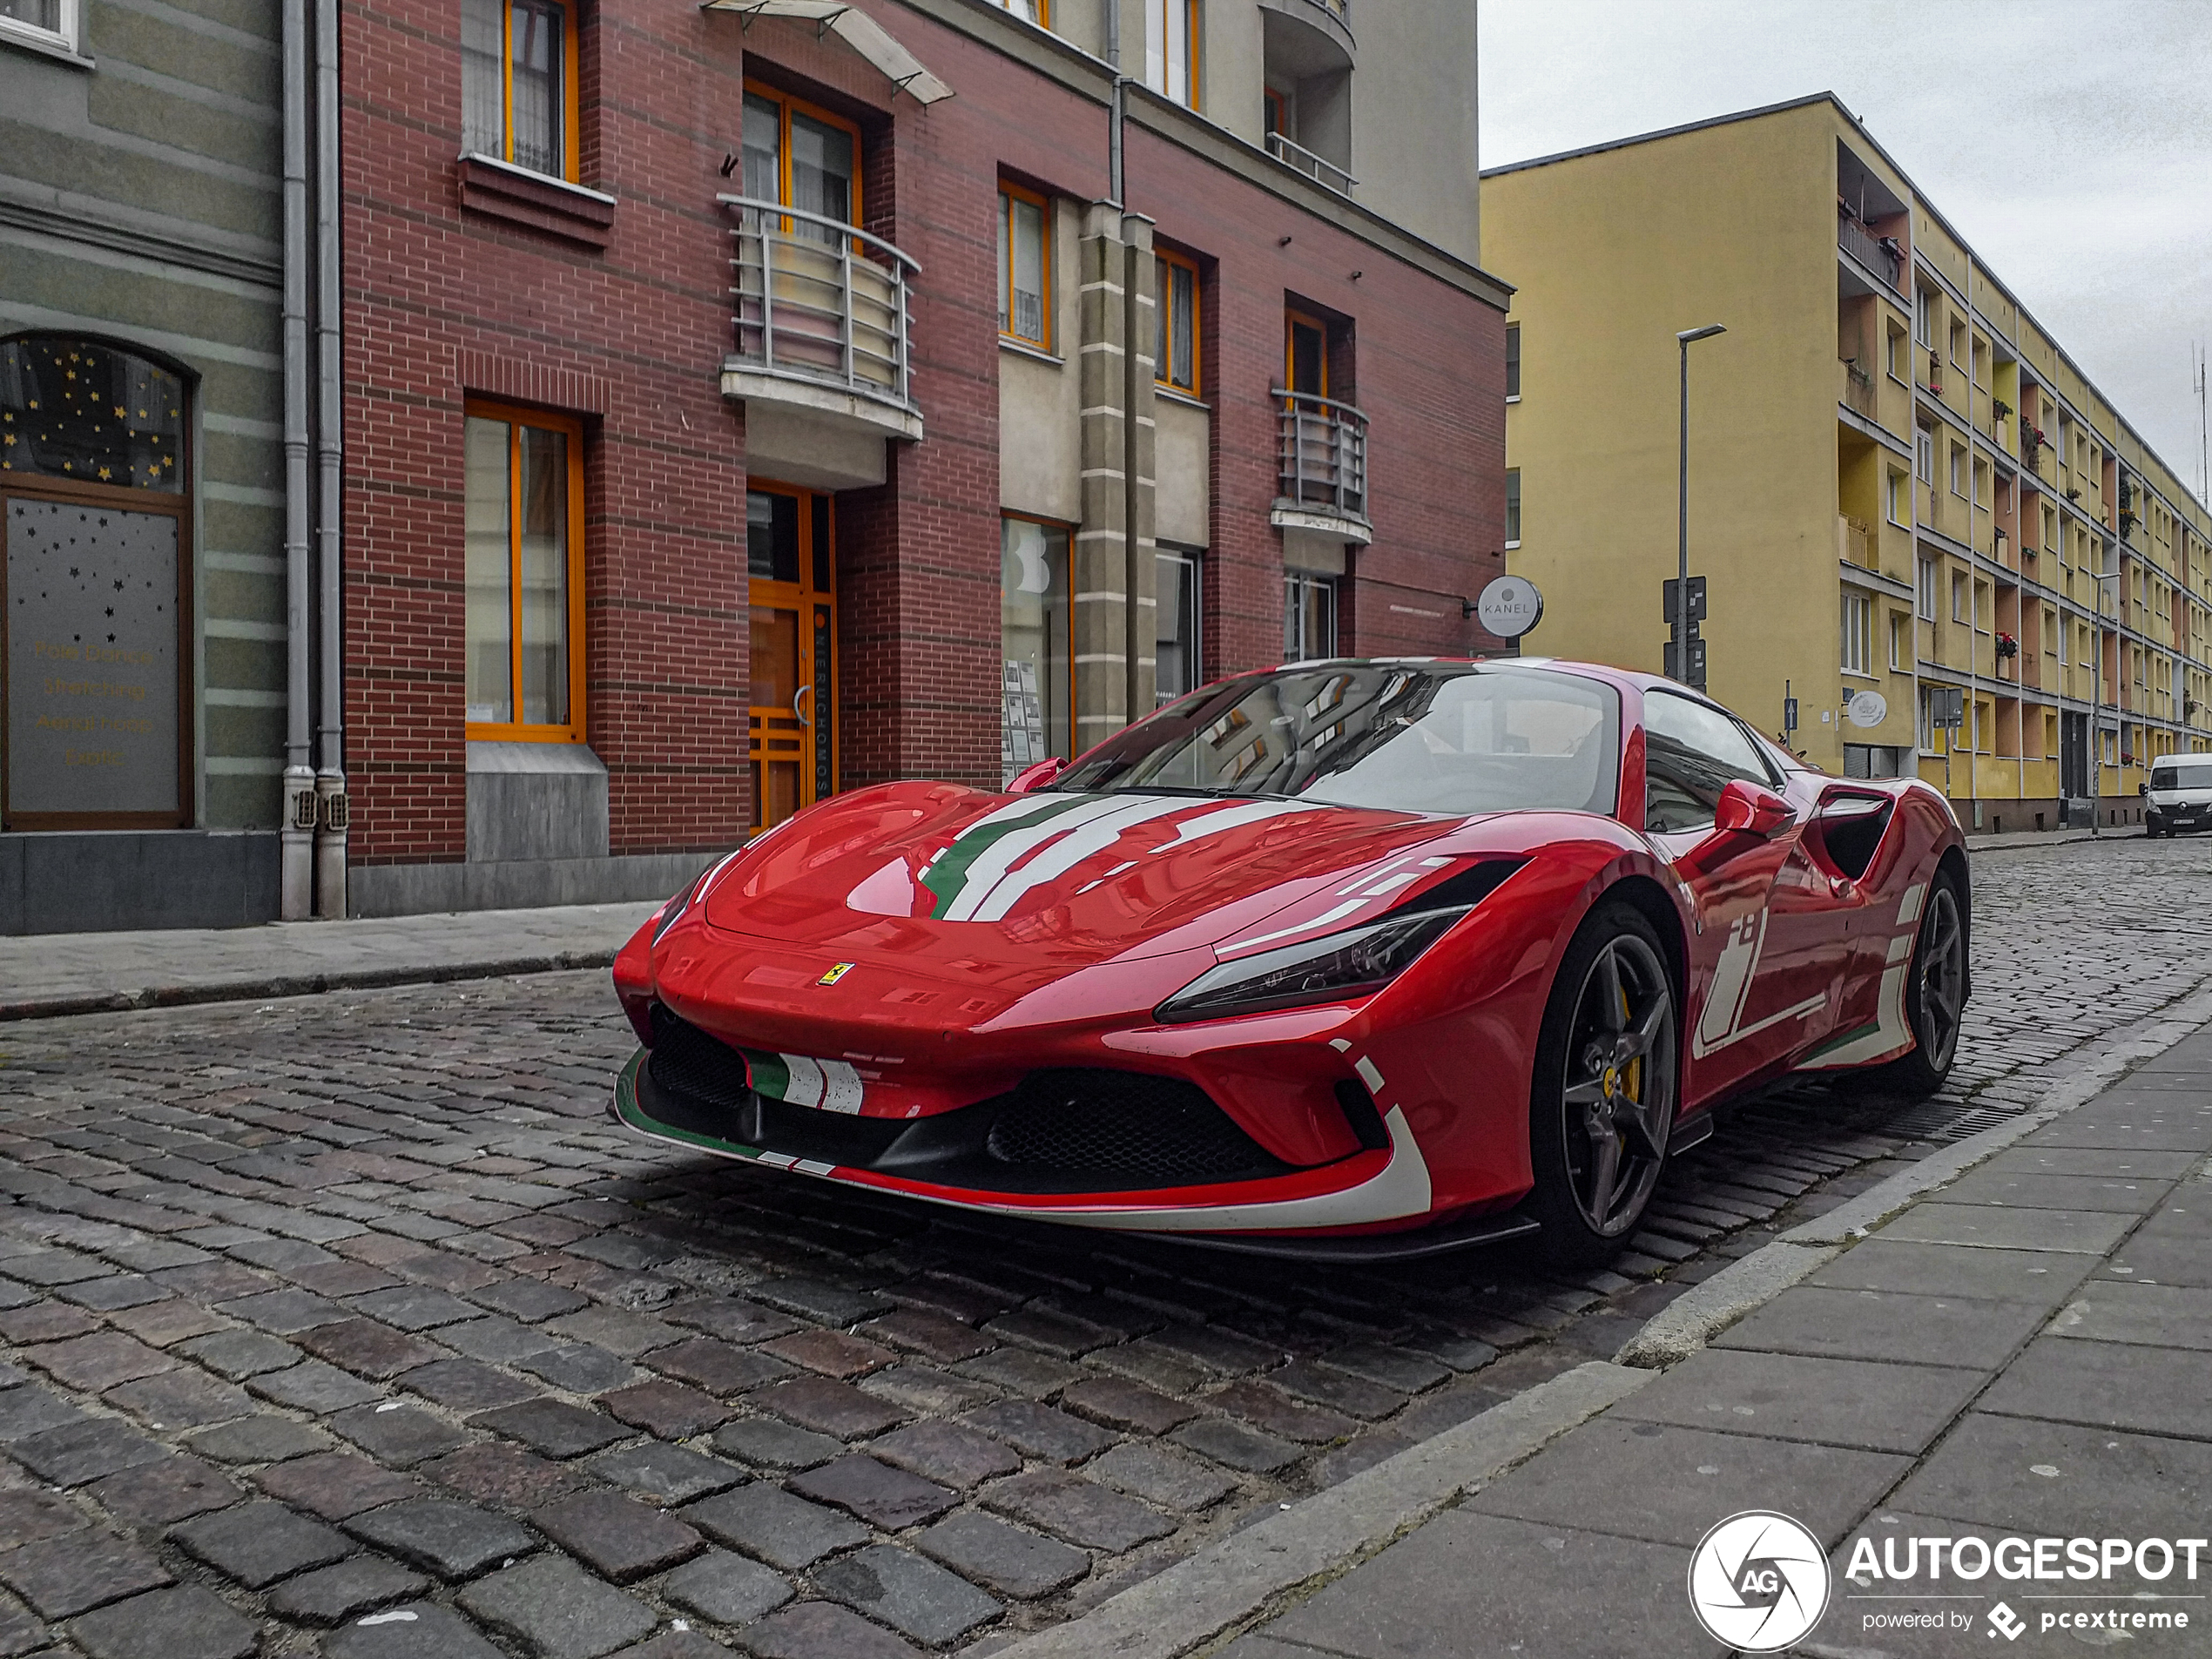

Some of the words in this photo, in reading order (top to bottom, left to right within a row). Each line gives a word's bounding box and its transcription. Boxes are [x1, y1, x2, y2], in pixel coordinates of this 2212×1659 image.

[1485, 604, 1529, 614] KANEL
[35, 640, 79, 660] Pole
[85, 644, 154, 665] Dance
[44, 677, 145, 701] Stretching
[35, 713, 95, 732] Aerial
[65, 747, 125, 766] Exotic
